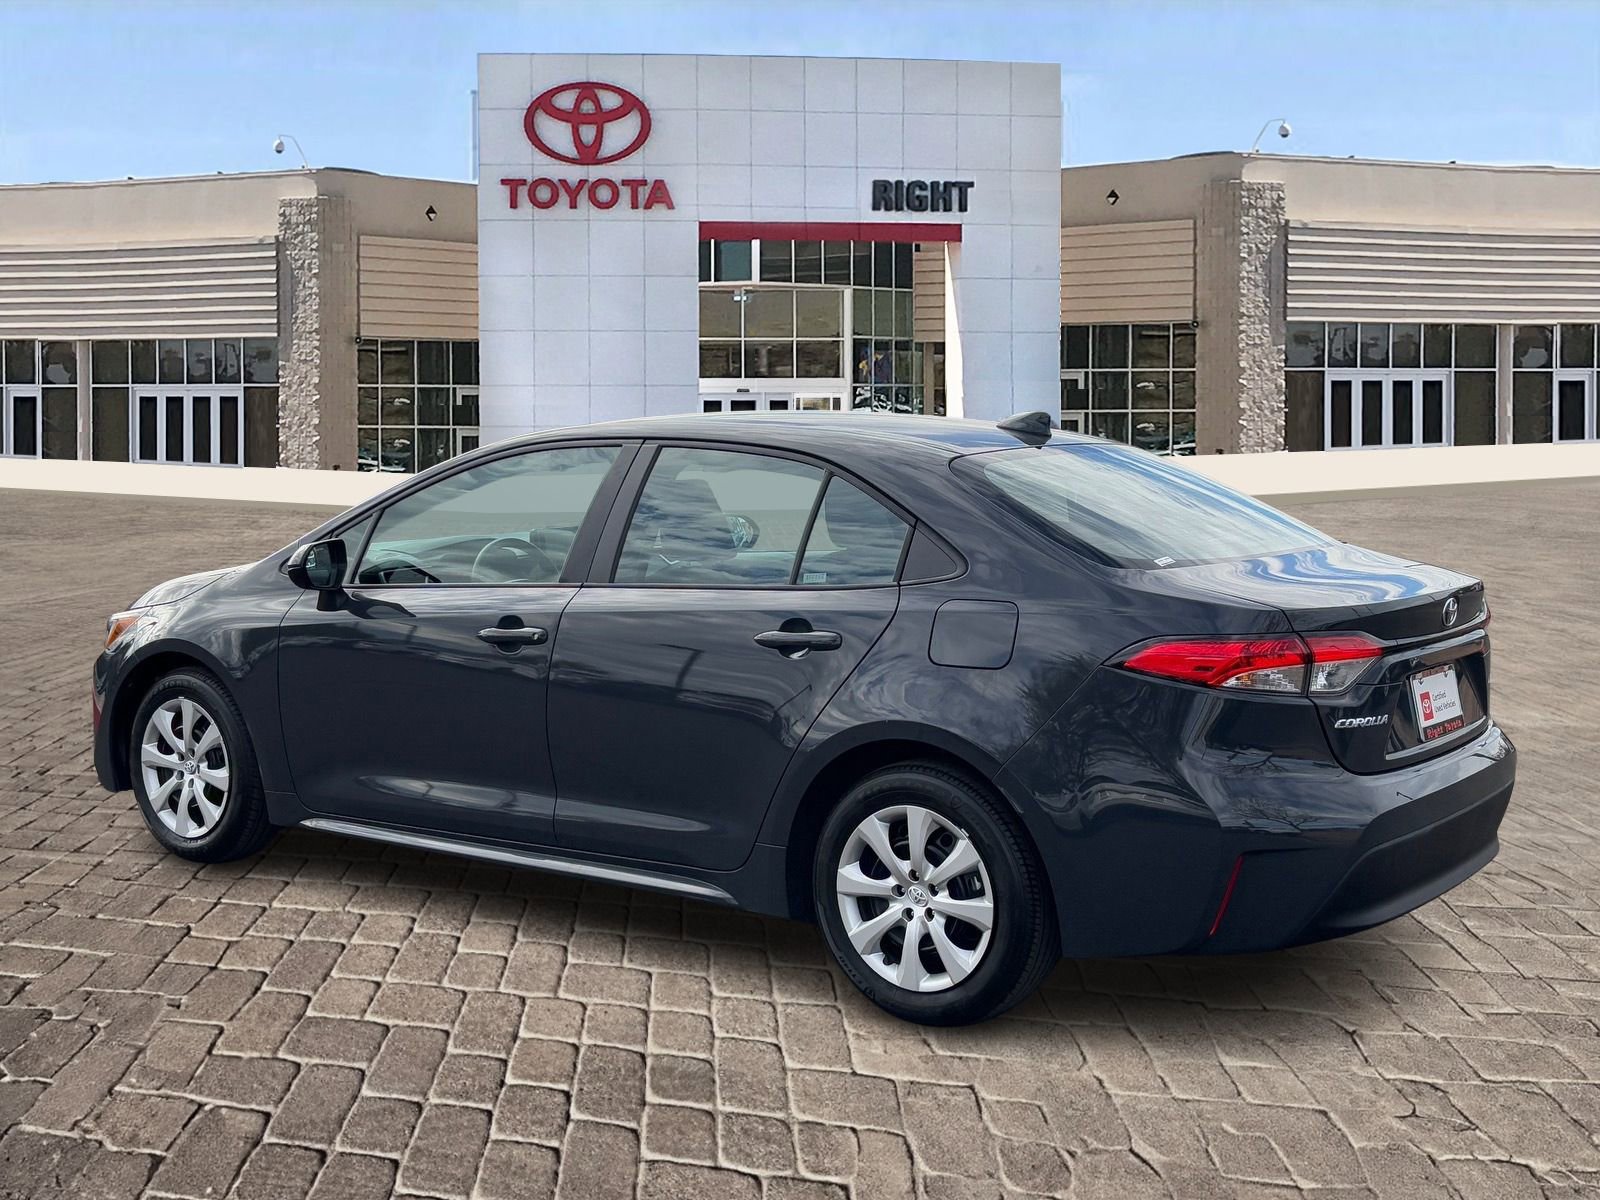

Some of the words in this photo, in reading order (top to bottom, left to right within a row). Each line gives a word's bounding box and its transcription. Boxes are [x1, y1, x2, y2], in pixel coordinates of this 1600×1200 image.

[500, 178, 675, 209] TOYOTA
[872, 179, 975, 212] RIGHT
[1334, 714, 1389, 729] COROLLA
